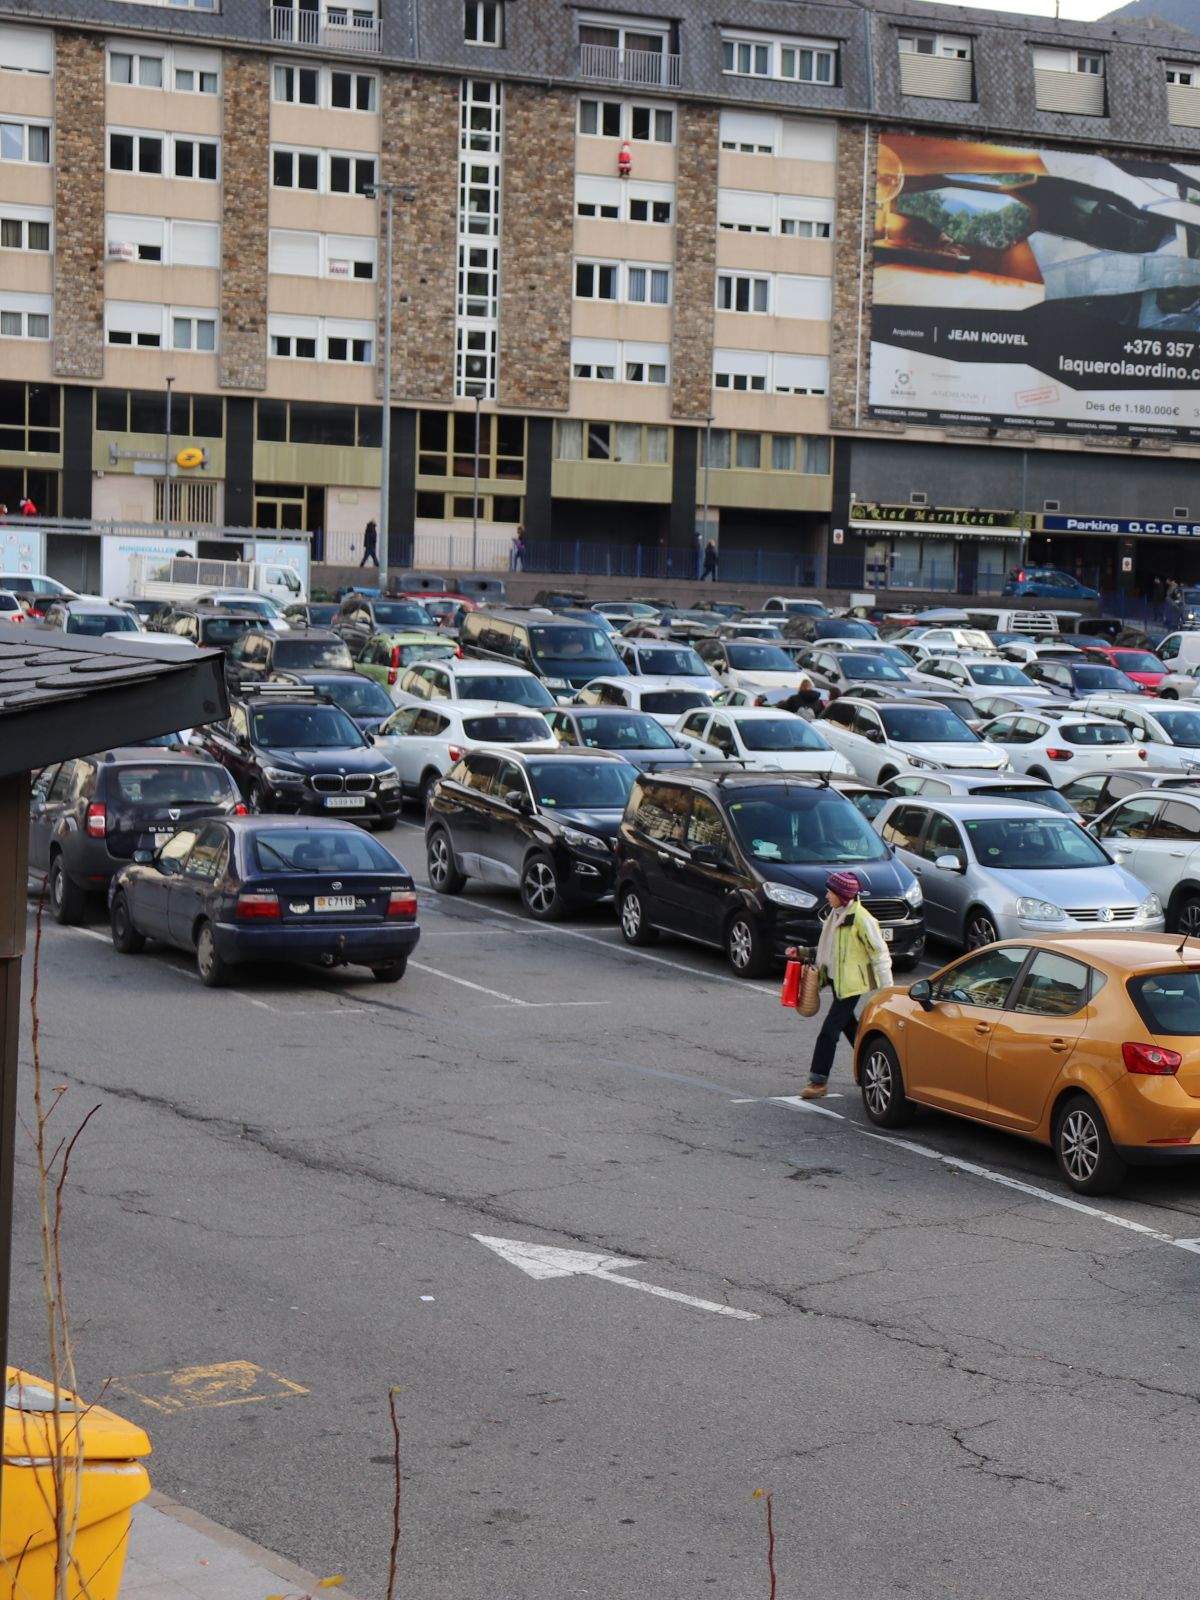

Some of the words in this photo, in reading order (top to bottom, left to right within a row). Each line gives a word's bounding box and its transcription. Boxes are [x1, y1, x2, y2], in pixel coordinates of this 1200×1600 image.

[948, 329, 979, 342] JEAN
[981, 331, 1029, 346] NOUVEL
[1123, 339, 1162, 356] +376
[1166, 341, 1195, 358] 357
[1086, 401, 1105, 411] Des
[1109, 402, 1121, 412] de
[1125, 404, 1180, 416] 1.180.000€
[1066, 518, 1119, 533] Parking
